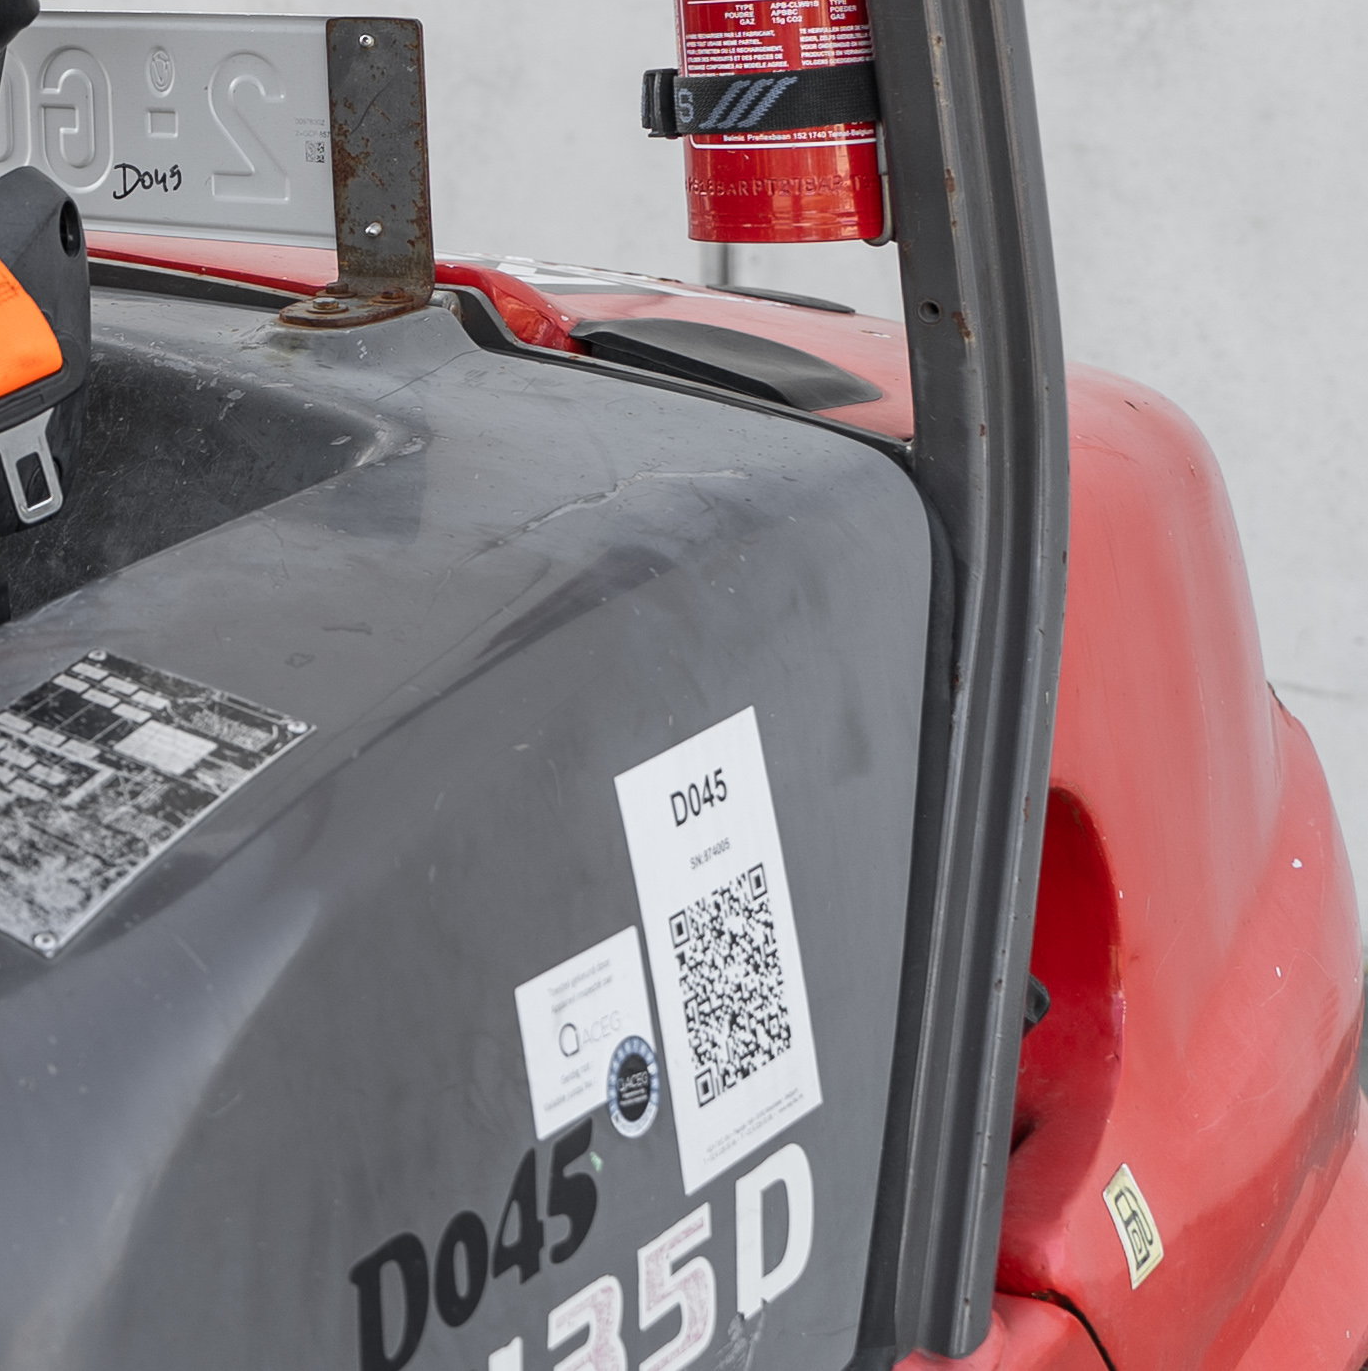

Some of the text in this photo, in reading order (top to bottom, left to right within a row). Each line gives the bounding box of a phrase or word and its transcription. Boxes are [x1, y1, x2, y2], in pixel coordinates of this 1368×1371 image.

[792, 131, 807, 139] 152
[669, 767, 728, 827] D045
[581, 1009, 621, 1045] ACEG
